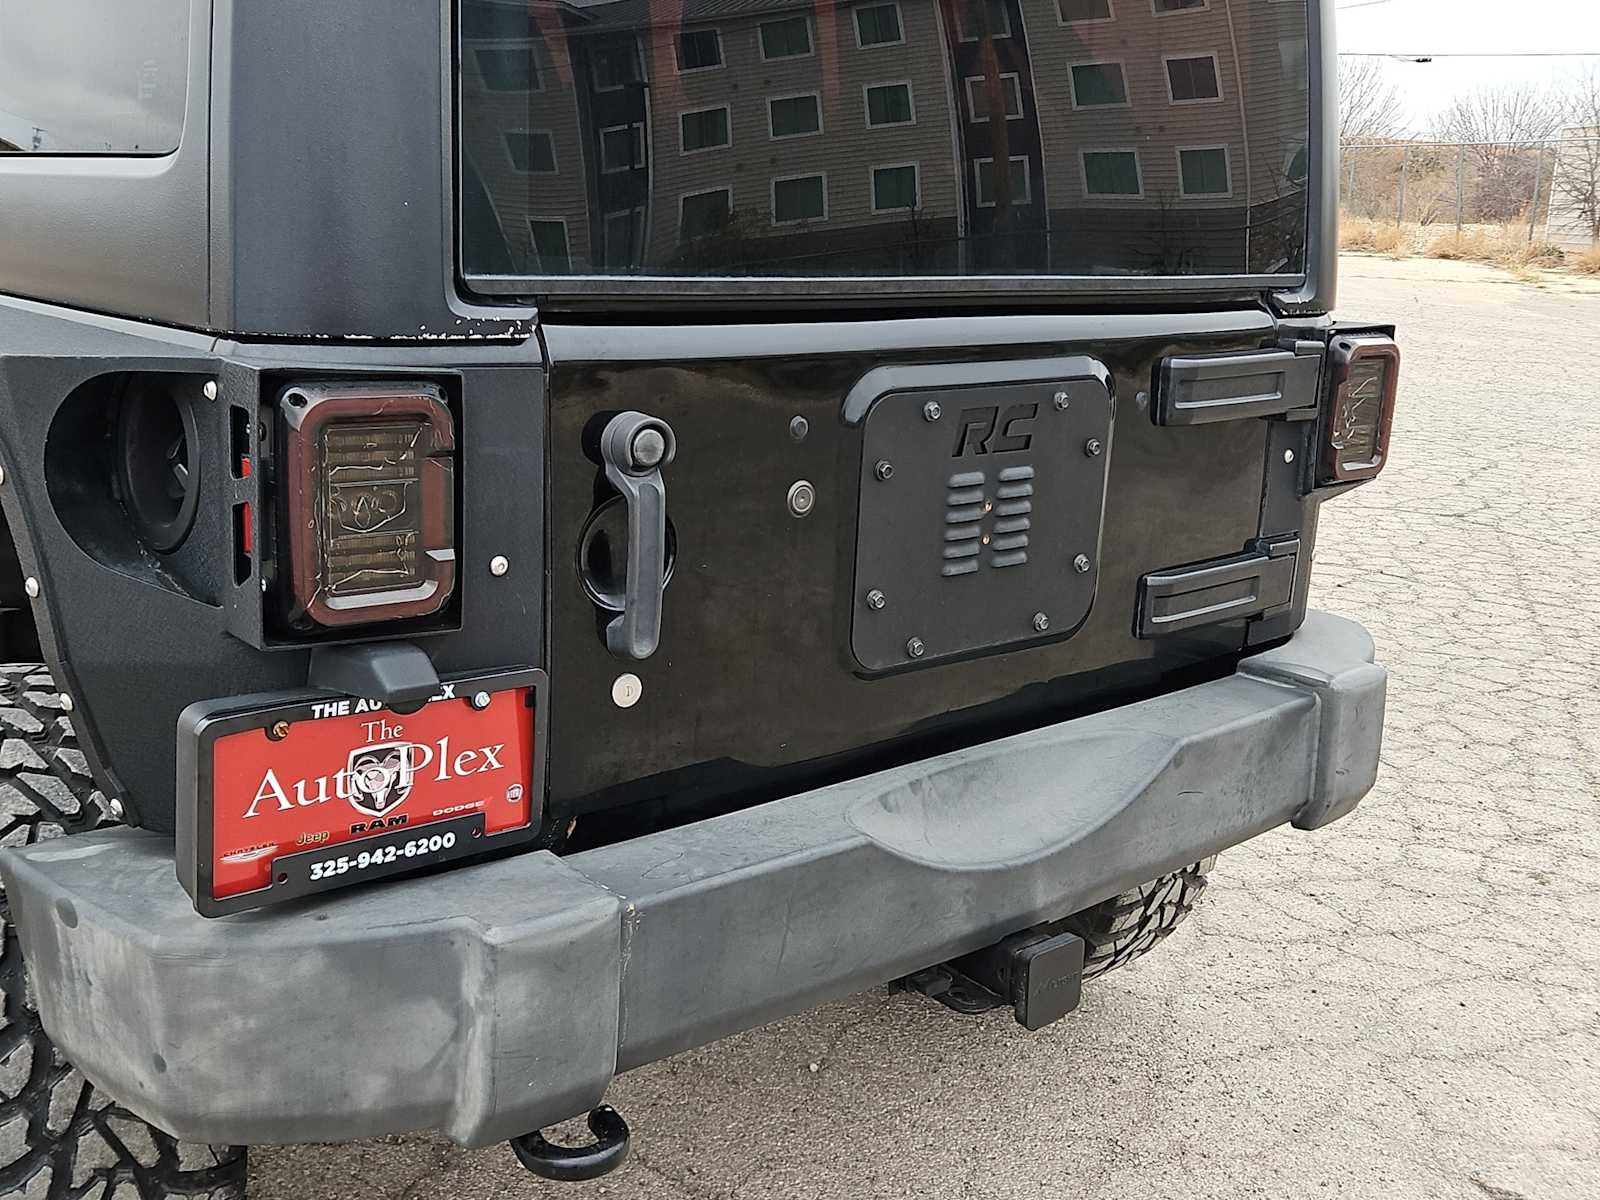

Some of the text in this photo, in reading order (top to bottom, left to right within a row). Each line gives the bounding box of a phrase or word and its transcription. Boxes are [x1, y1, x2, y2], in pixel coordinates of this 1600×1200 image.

[952, 403, 1039, 457] RC
[312, 700, 350, 719] THE
[361, 720, 404, 744] The
[243, 736, 506, 819] AutoPlex
[432, 800, 485, 817] DODGE
[349, 813, 409, 835] RAM
[296, 831, 330, 846] Jeep
[310, 832, 456, 882] 325-942-6200
